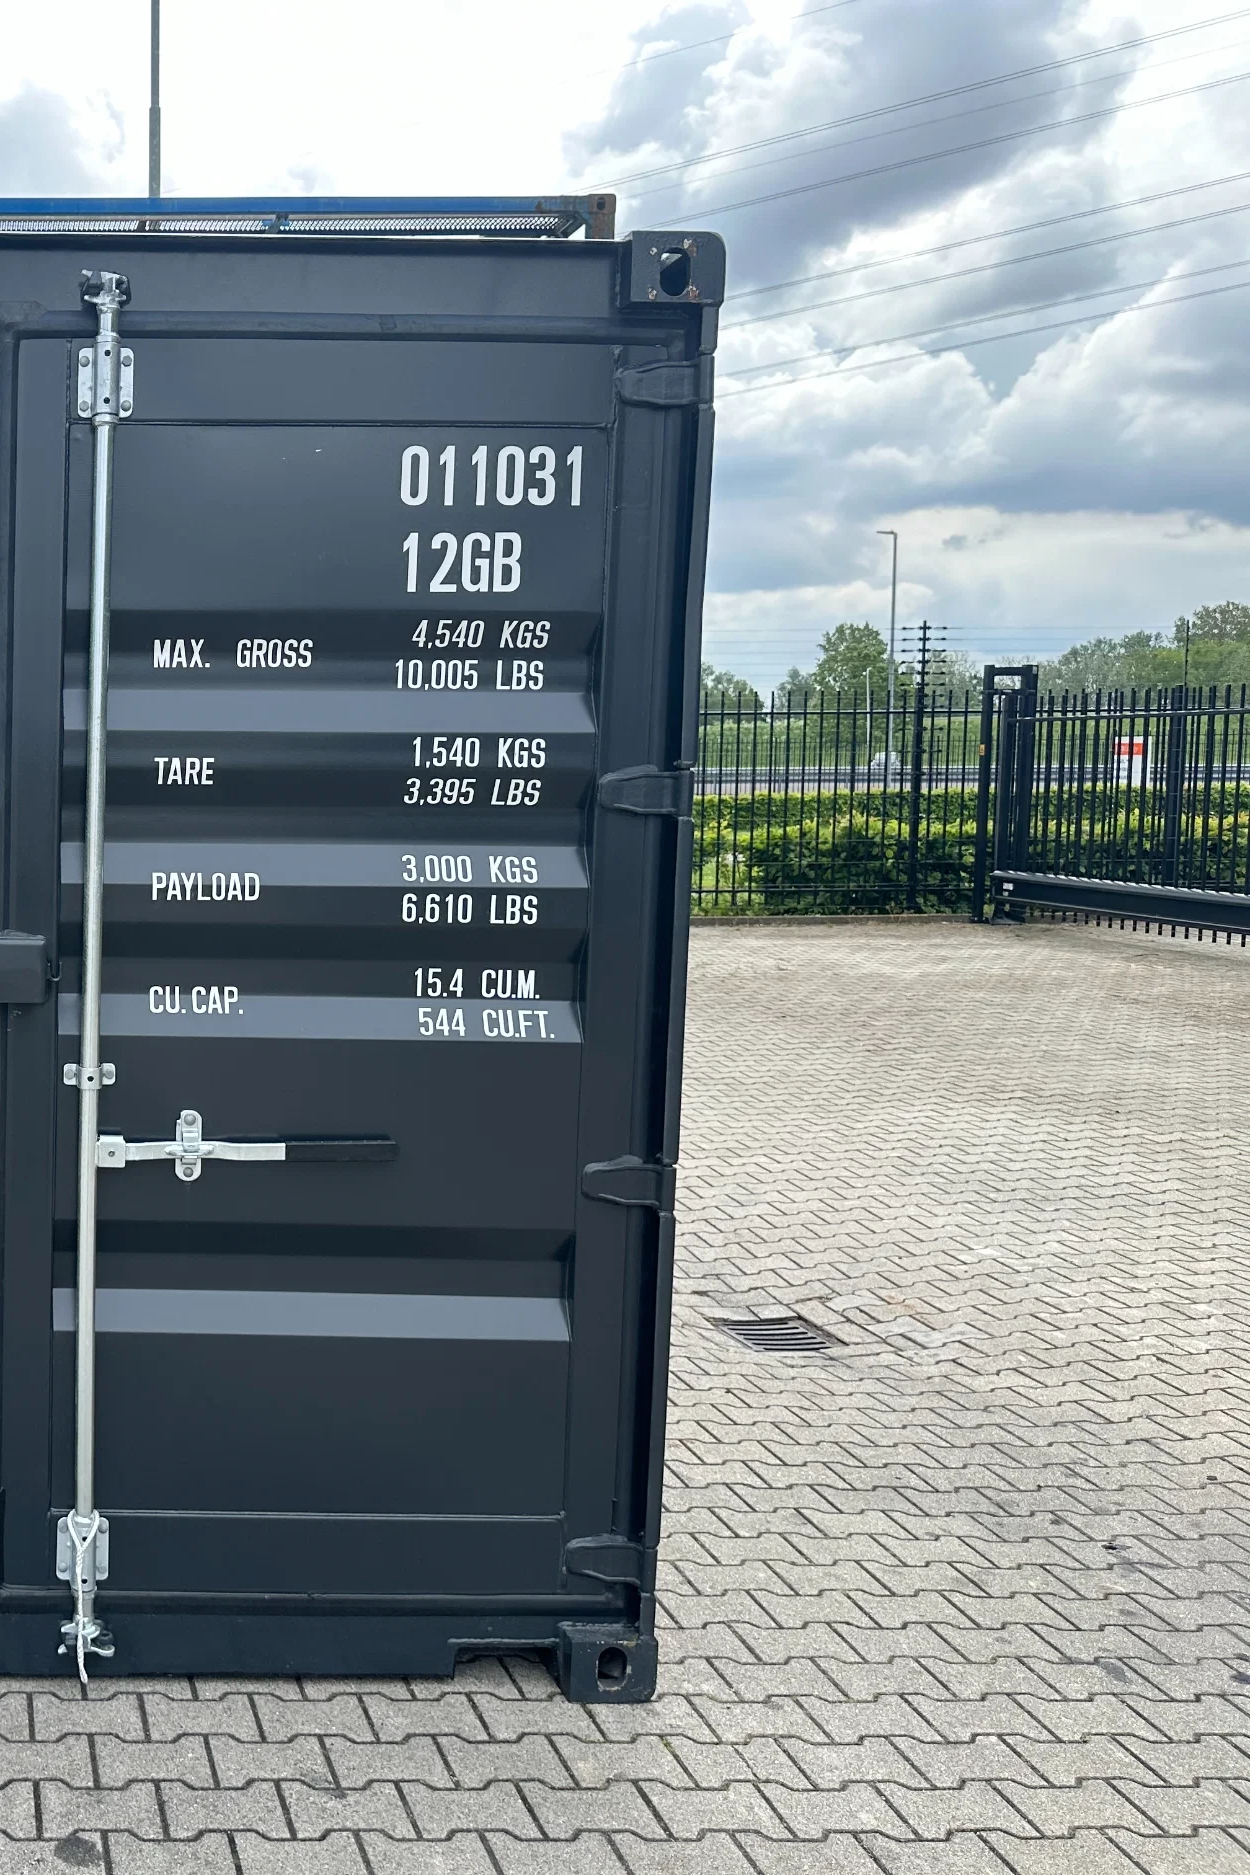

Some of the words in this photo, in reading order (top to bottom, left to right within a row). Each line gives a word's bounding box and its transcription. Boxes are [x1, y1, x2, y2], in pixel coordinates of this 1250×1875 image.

[399, 445, 584, 507] 011031
[402, 531, 523, 593] 12GB
[411, 619, 485, 649] 4,540
[499, 620, 551, 649] KGS
[153, 638, 211, 668] MAX.
[236, 638, 314, 668] GROSS
[395, 659, 479, 691] 10,005
[495, 660, 545, 690] LBS
[412, 736, 480, 768] 1,540
[497, 738, 546, 769] KGS
[154, 757, 215, 786] TARE
[403, 778, 477, 806] 3,395
[490, 779, 542, 806] LBS
[401, 854, 474, 884] 3,000
[488, 855, 539, 884] KGS
[151, 872, 261, 901] PAYLOAD
[401, 894, 474, 925] 6,610
[489, 894, 539, 925] LBS
[414, 967, 464, 998] 15.4
[418, 1007, 466, 1037] 544
